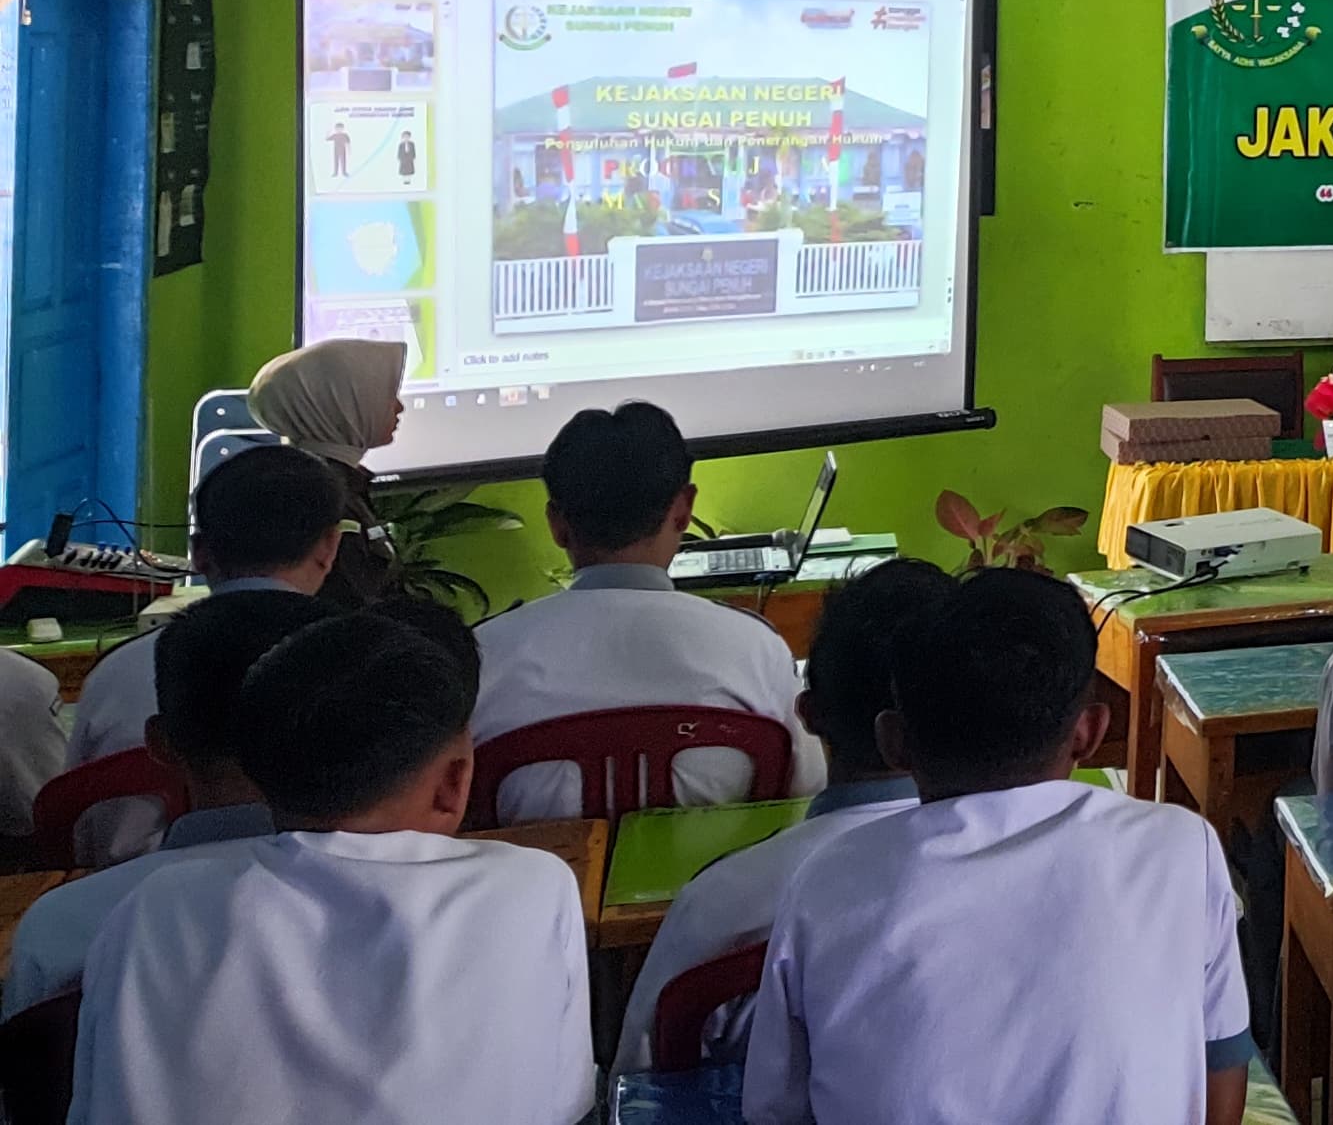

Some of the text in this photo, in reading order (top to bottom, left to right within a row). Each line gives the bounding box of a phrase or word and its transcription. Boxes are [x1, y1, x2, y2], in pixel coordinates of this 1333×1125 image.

[596, 84, 843, 103] KEJAKSAAN NEGERI
[627, 109, 812, 130] SUNGAI PENUH
[463, 354, 486, 365] Click
[488, 355, 499, 364] to
[502, 352, 520, 363] add
